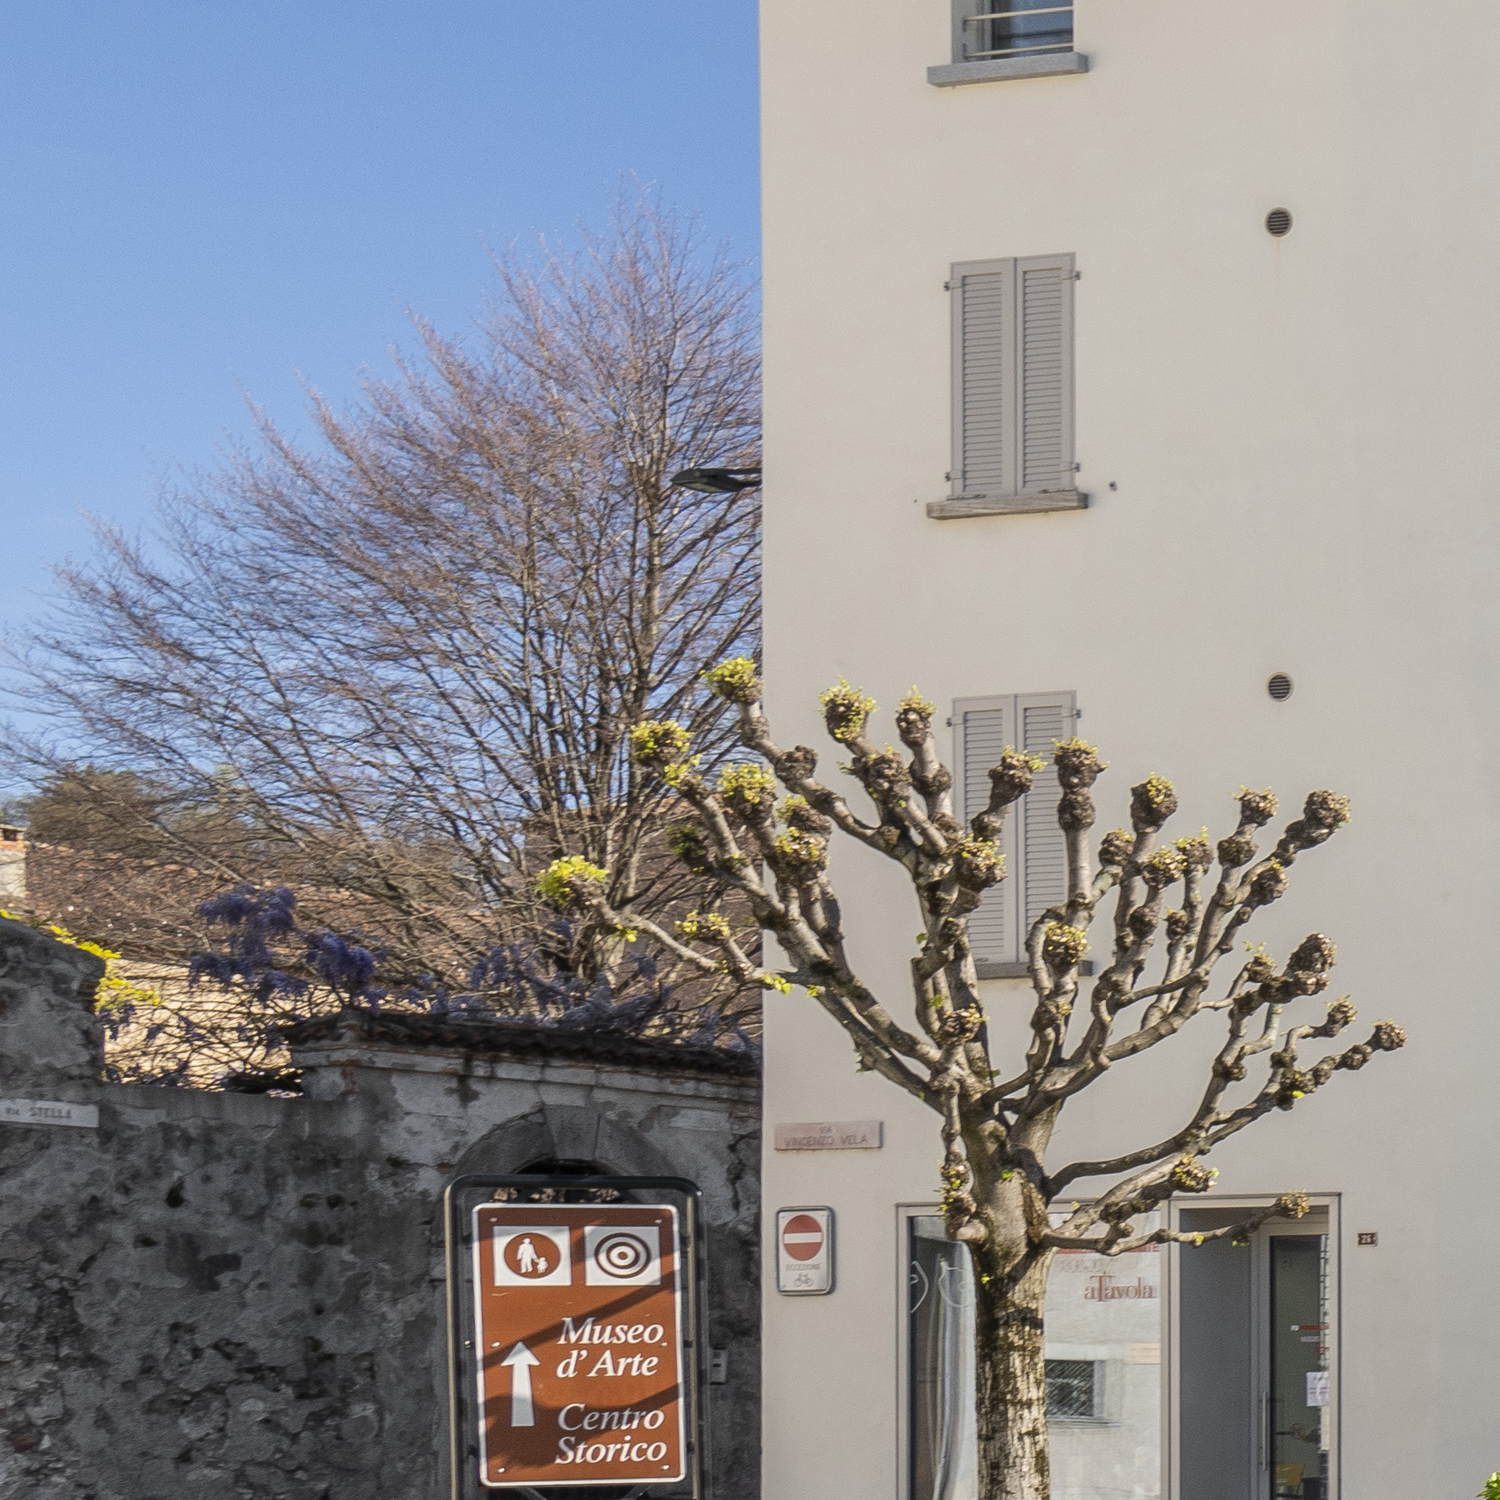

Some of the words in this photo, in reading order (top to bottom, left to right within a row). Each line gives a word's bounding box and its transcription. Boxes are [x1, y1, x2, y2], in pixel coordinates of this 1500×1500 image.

[840, 1134, 868, 1146] VELA
[557, 1316, 664, 1345] Museo
[558, 1403, 665, 1431] Centro
[555, 1435, 668, 1464] Storico
